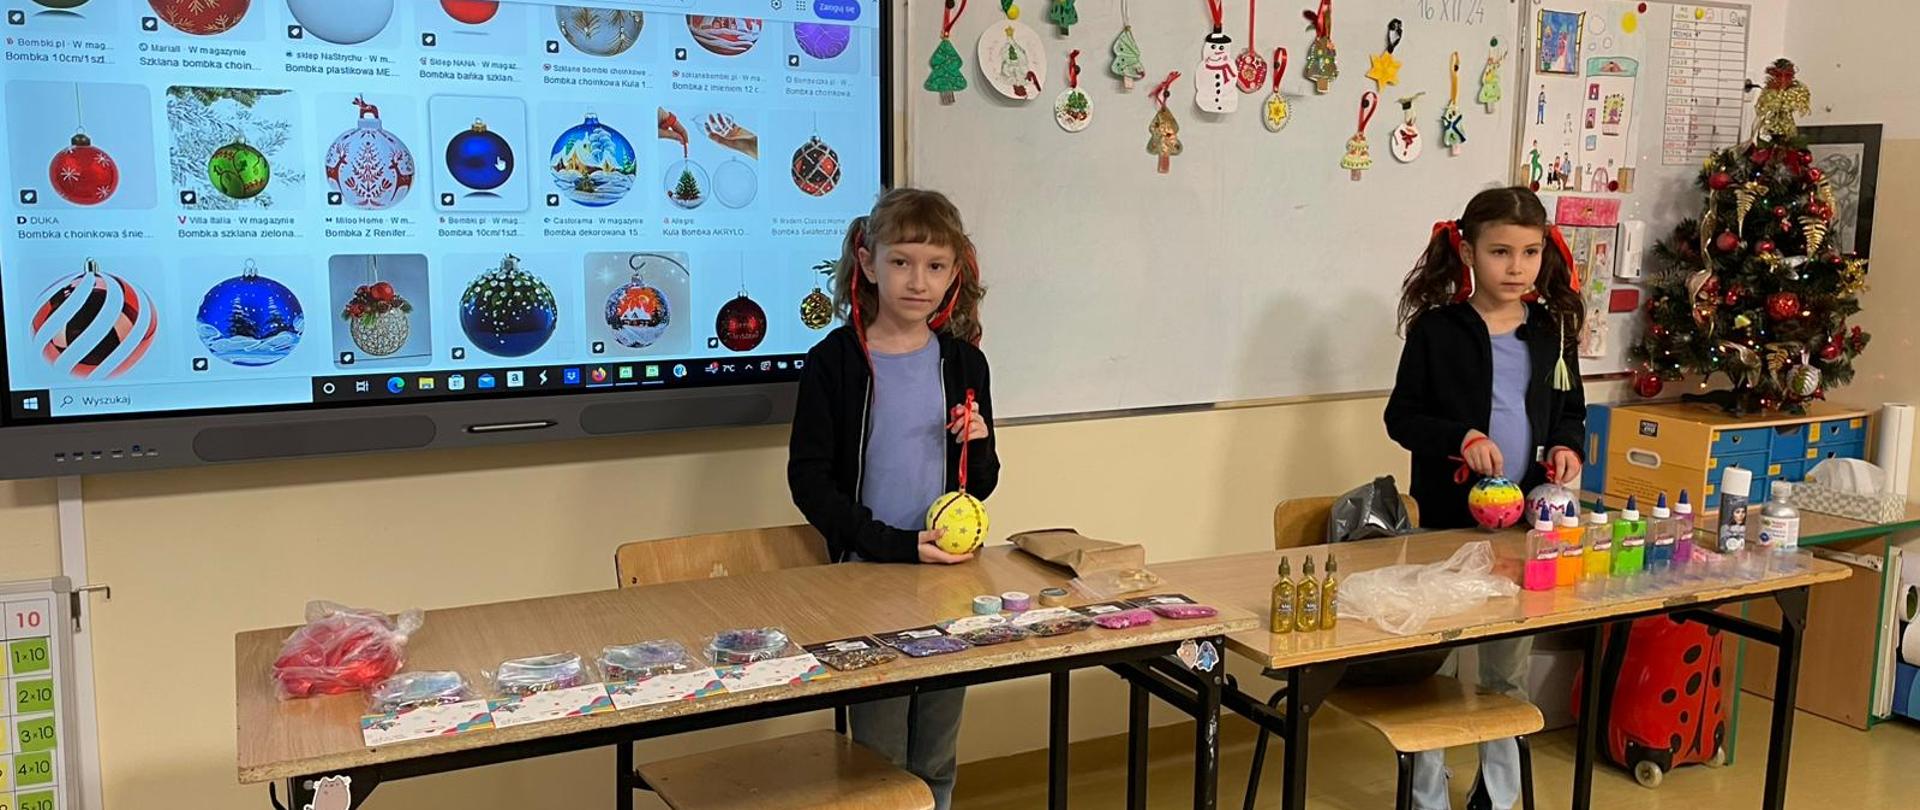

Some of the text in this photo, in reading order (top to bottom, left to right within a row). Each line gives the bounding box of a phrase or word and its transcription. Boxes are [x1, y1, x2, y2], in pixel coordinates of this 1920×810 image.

[72, 40, 82, 48] W
[5, 51, 49, 62] Bombka
[188, 46, 198, 54] W
[199, 47, 246, 57] magazynie
[139, 56, 180, 67] Szklana
[182, 57, 222, 69] bombka
[369, 54, 379, 63] W
[285, 63, 324, 74] Bombka
[326, 65, 375, 77] plastikowa
[481, 61, 491, 69] W
[419, 70, 455, 80] Bombka
[543, 76, 576, 87] Bombka
[577, 77, 620, 89] choinkowa
[620, 79, 640, 89] Kula
[672, 82, 703, 91] Bombka
[785, 87, 813, 96] Bombka
[30, 216, 59, 225] DUKA
[189, 216, 209, 225] Villa
[209, 216, 232, 225] Italia
[238, 216, 248, 225] W
[249, 217, 295, 227] magazynie
[358, 216, 384, 225] Home
[390, 216, 400, 225] W
[492, 217, 502, 225] W
[553, 216, 644, 227] Castorama W magazynie
[18, 229, 61, 239] Bombka
[63, 229, 119, 239] choinkowa
[178, 228, 219, 239] Bombka
[220, 228, 258, 239] szklana
[325, 228, 363, 238] Bombka
[365, 228, 372, 238] Z
[438, 228, 474, 238] Bombka
[543, 228, 576, 237] Bombka
[578, 228, 626, 238] dekorowana
[662, 228, 680, 237] Kula
[681, 228, 711, 237] Bombka
[771, 228, 801, 238] Bombka
[81, 394, 131, 408] Wyszukaj
[16, 610, 41, 628] 10
